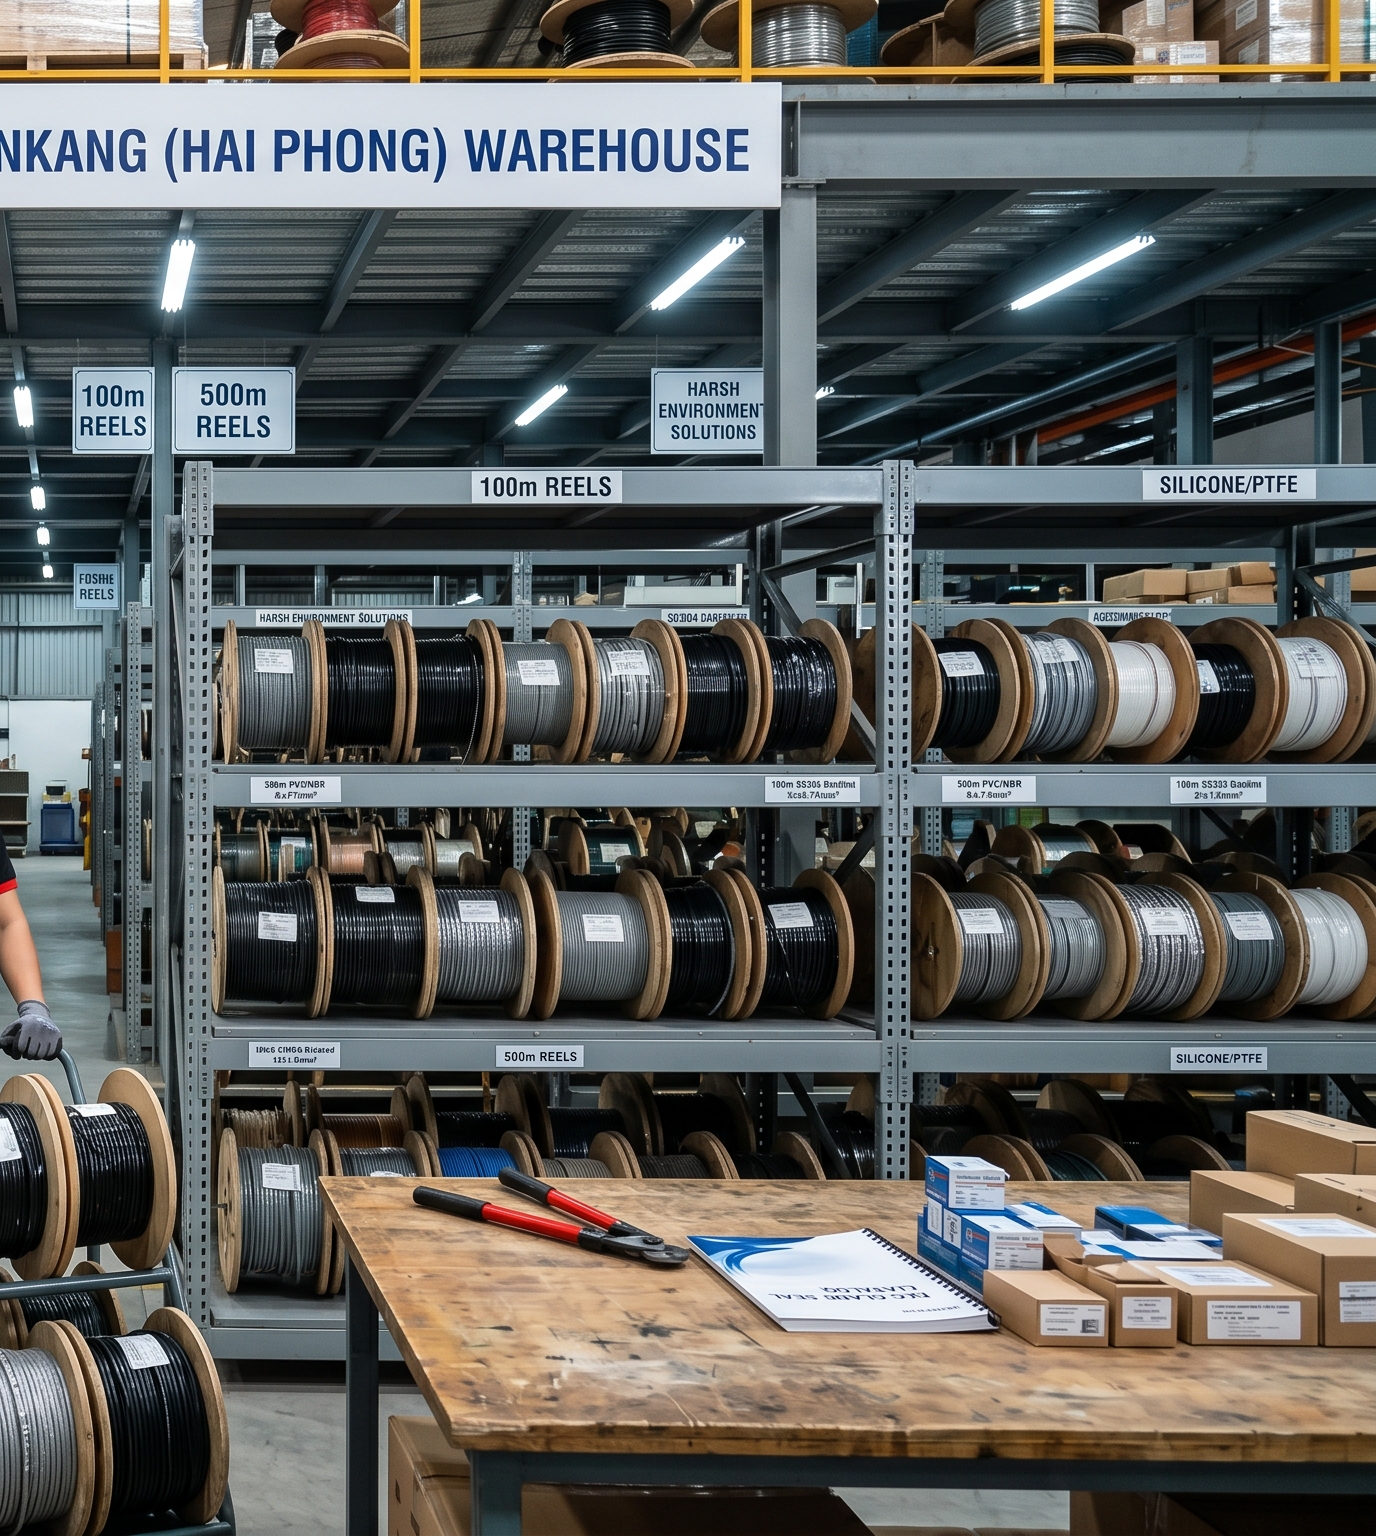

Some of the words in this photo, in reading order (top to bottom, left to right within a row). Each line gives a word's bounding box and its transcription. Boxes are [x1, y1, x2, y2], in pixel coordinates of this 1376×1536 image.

[165, 128, 255, 183] (HAI
[274, 127, 447, 183] PHONG)
[464, 128, 750, 173] WAREHOUSE
[81, 385, 144, 407] 100m
[200, 383, 266, 407] 500m
[687, 381, 740, 397] HARSH
[80, 416, 147, 437] REELS
[197, 416, 271, 438] REELS
[671, 424, 757, 440] SOLUTIONS
[480, 476, 537, 497] 100m
[545, 475, 612, 497] REELS
[1160, 475, 1298, 495] SILICONE/PTFE
[79, 588, 114, 600] REELS
[259, 613, 290, 623] HARSH
[957, 779, 980, 788] 500m
[982, 779, 1023, 788] PVC/NBR
[504, 1051, 536, 1062] 500m
[539, 1051, 578, 1062] REELS
[1176, 1053, 1263, 1064] SILICONE/PTFE
